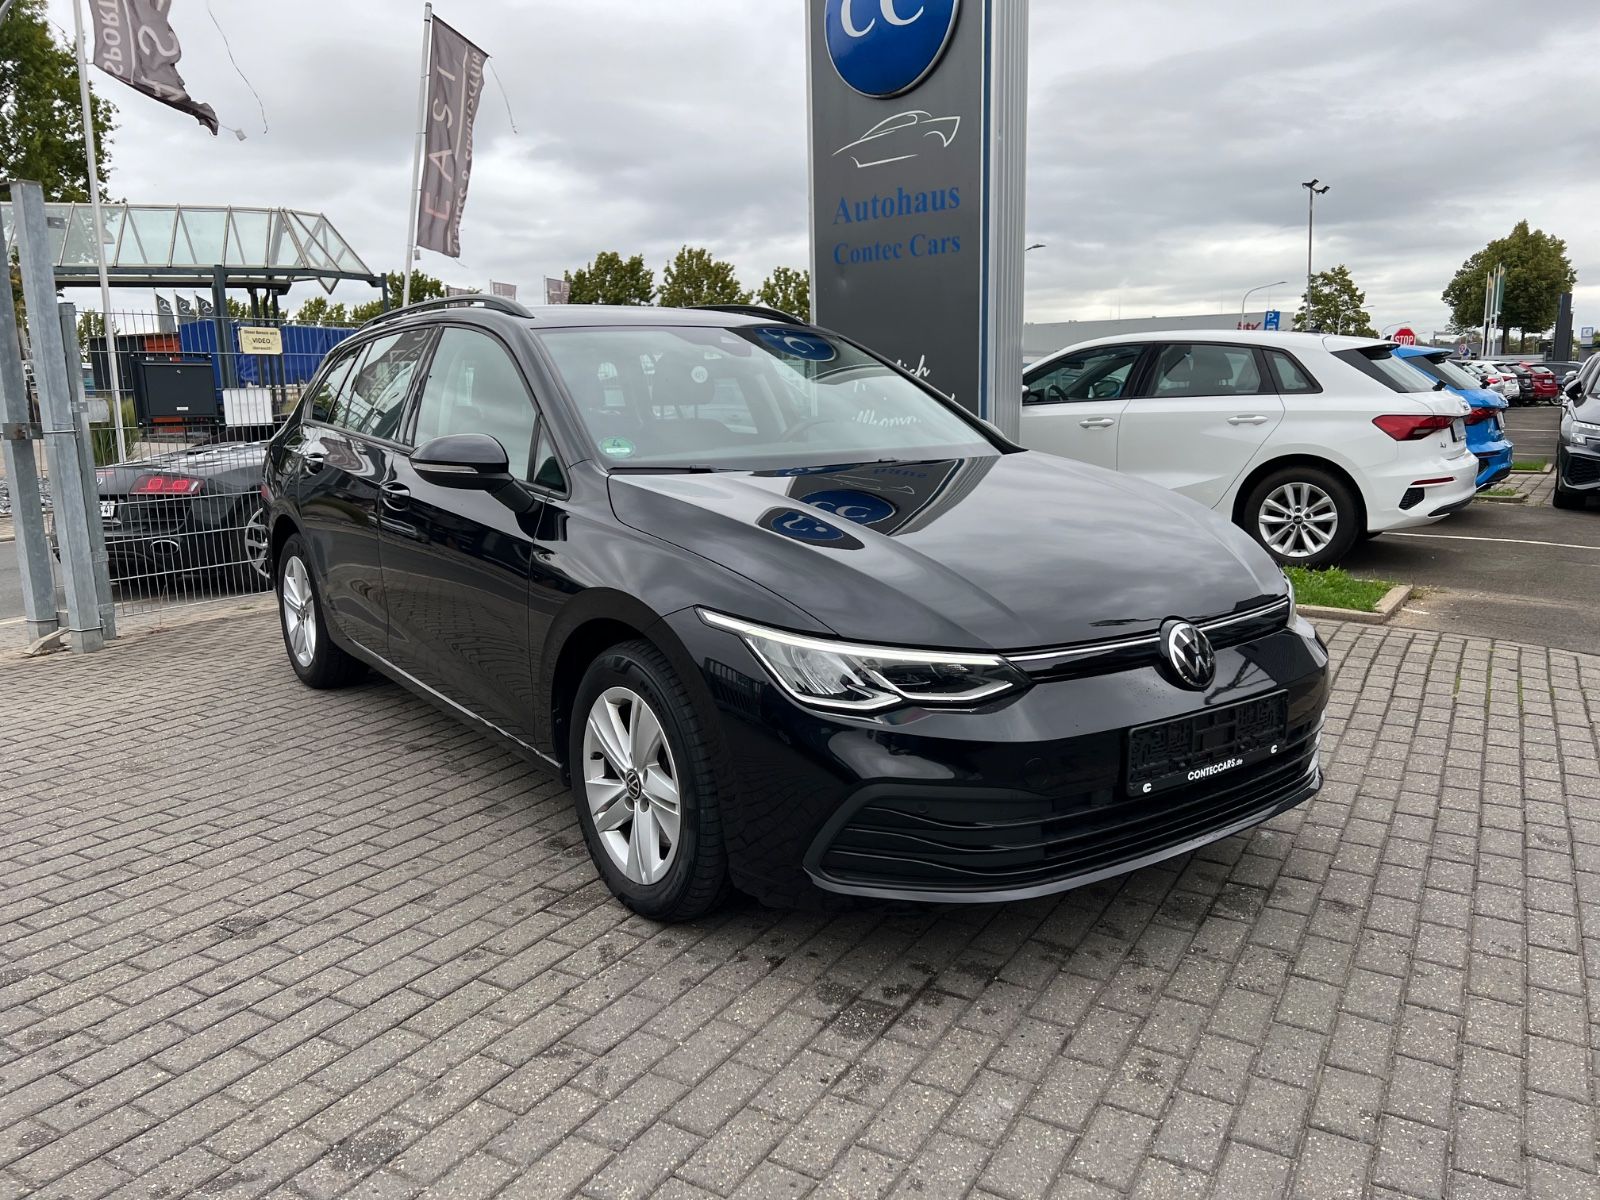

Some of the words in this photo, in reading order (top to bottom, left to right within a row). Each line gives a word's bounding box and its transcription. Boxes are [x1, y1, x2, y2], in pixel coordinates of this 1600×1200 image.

[832, 186, 961, 226] Autohaus
[833, 241, 903, 265] Contec
[910, 233, 961, 257] Cars
[1394, 335, 1415, 346] STOP
[1187, 758, 1243, 781] CONTECCARS.de
